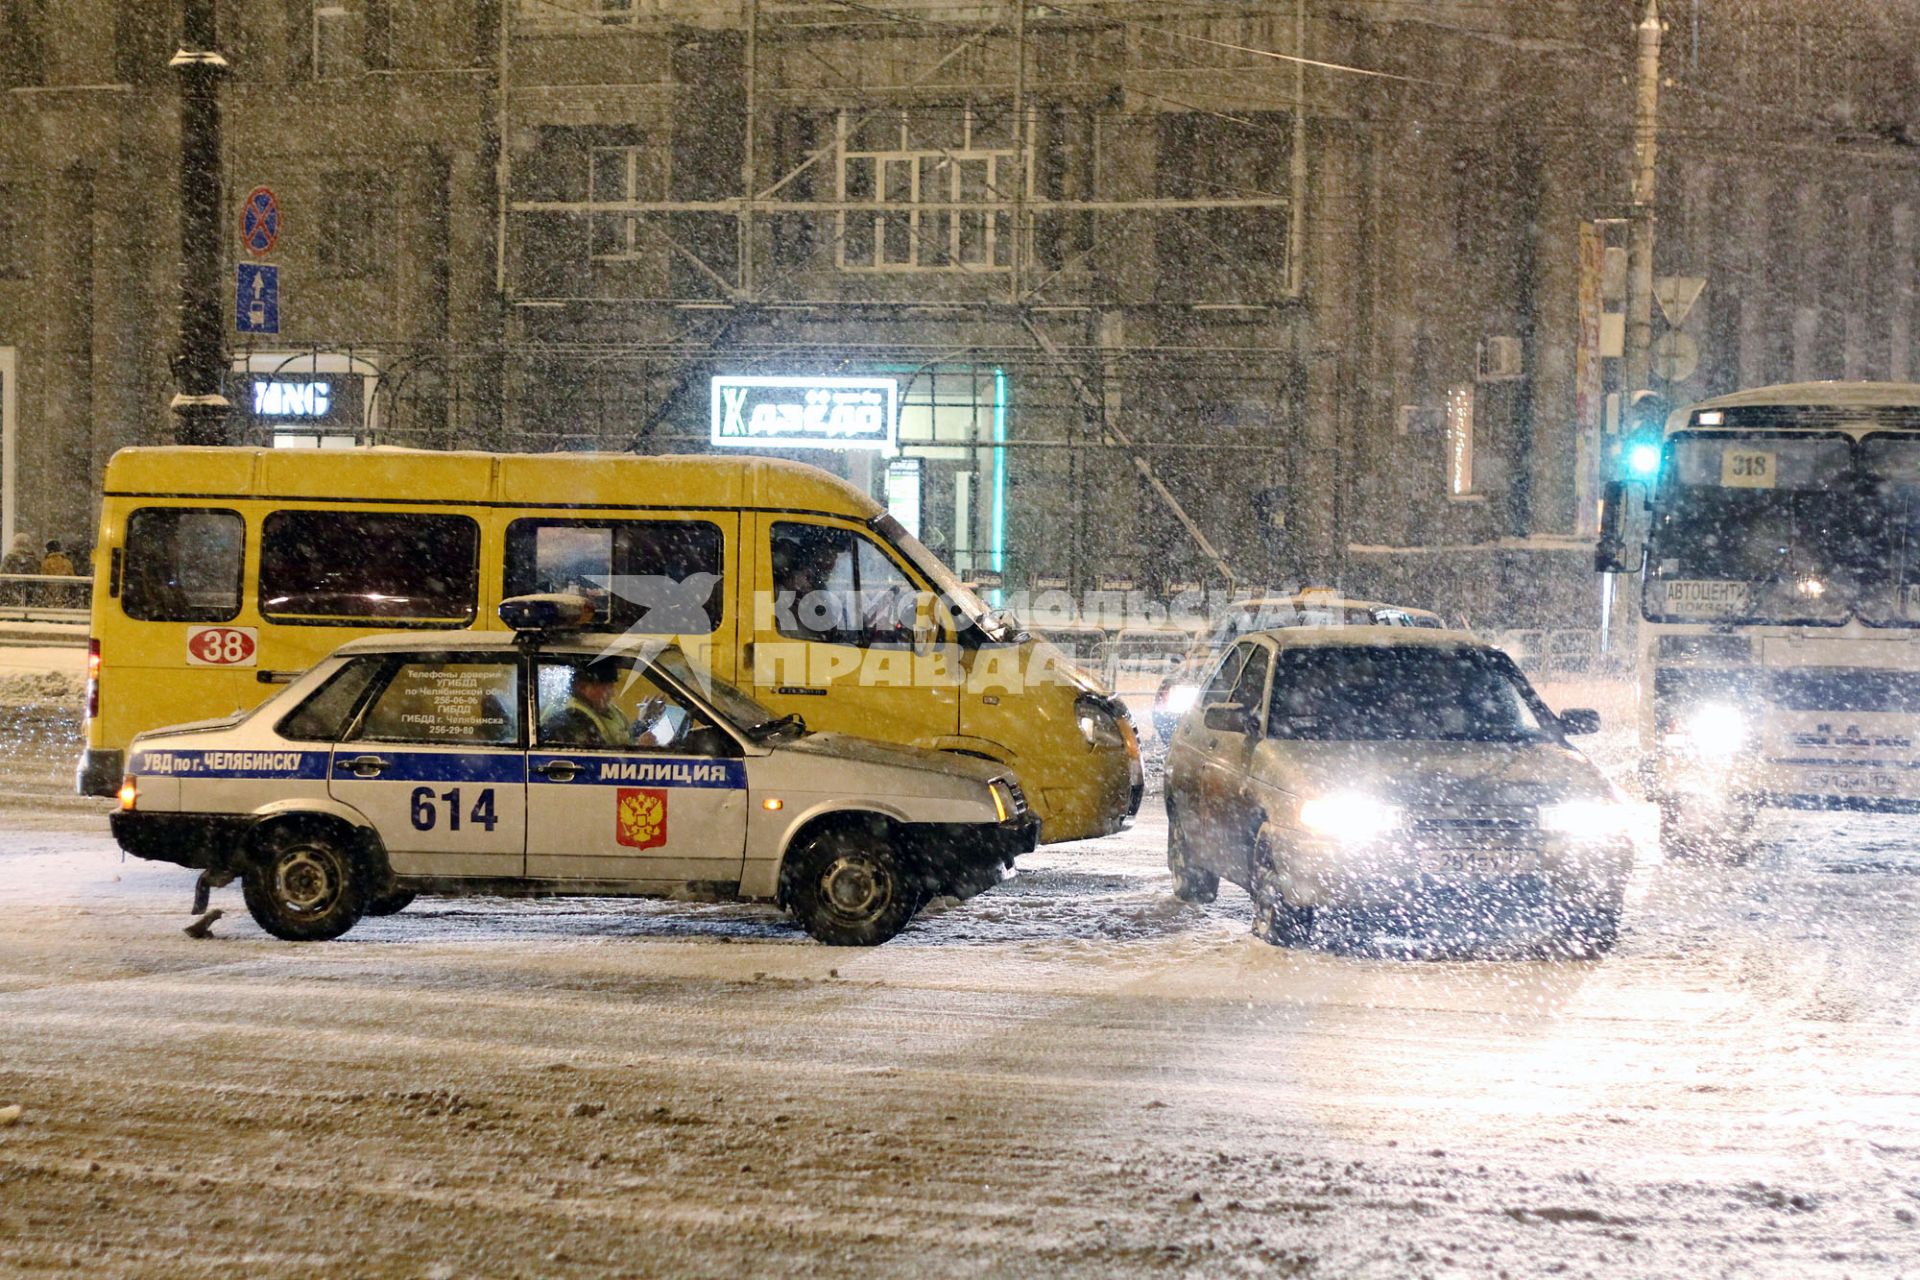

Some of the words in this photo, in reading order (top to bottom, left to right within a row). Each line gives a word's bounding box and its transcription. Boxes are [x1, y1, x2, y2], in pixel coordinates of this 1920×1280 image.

[1733, 455, 1766, 476] 318
[203, 631, 243, 662] 38
[405, 688, 417, 696] по
[401, 714, 435, 724] ГИБДД
[143, 753, 173, 774] УВД
[174, 758, 191, 771] по
[204, 752, 302, 771] ЧЕЛЯБИНСКУ
[601, 762, 727, 784] МИЛИЦИЯ
[411, 786, 498, 832] 614
